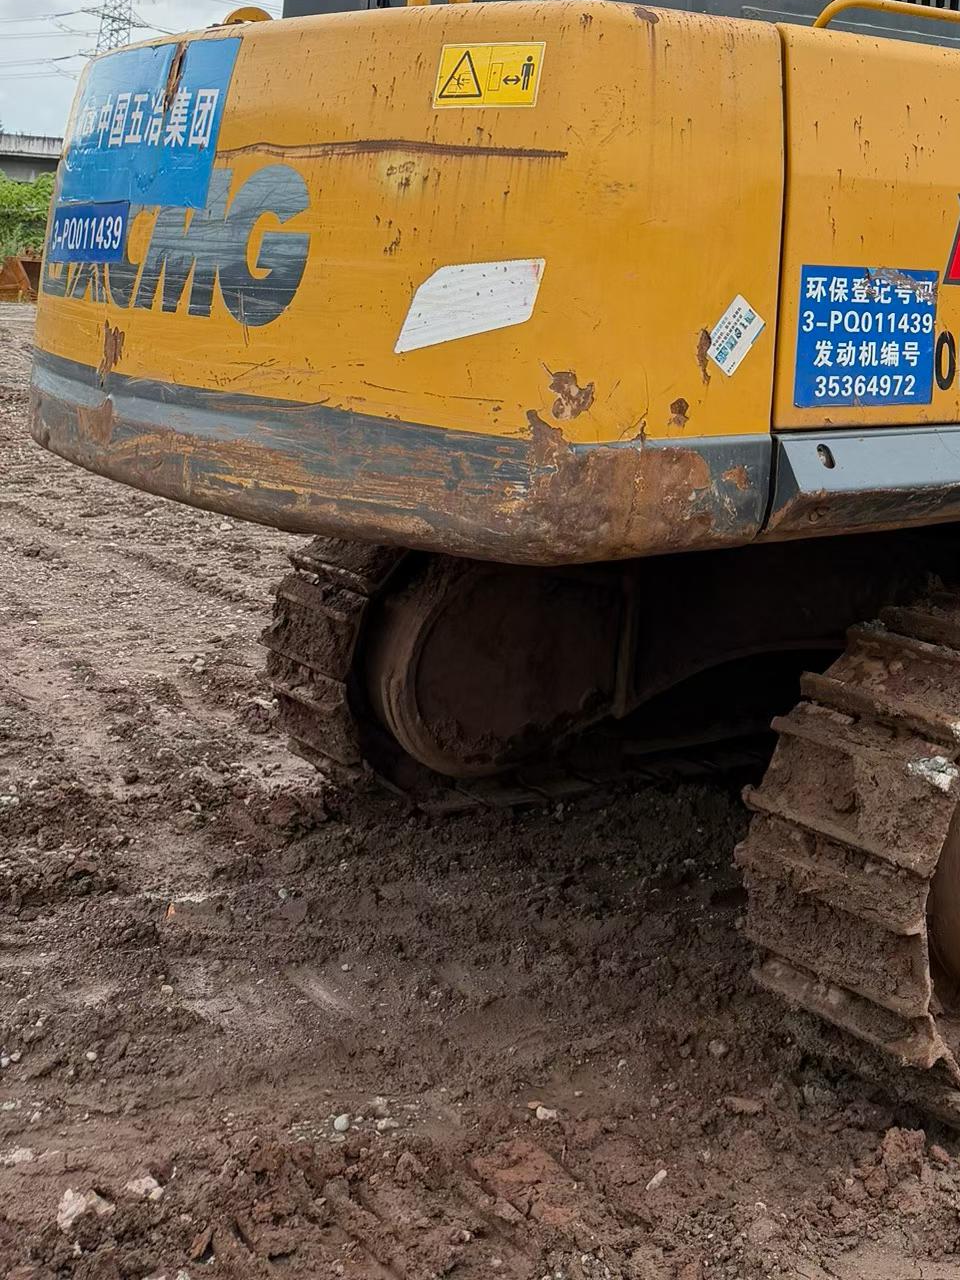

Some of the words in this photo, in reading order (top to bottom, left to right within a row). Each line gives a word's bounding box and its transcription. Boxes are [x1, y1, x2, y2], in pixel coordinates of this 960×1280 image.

[52, 216, 123, 251] 3-PQ011439
[67, 164, 312, 327] CMG
[802, 310, 934, 334] 3-PQ011439
[813, 340, 921, 368] 发动机编号
[814, 374, 916, 398] 35364972
